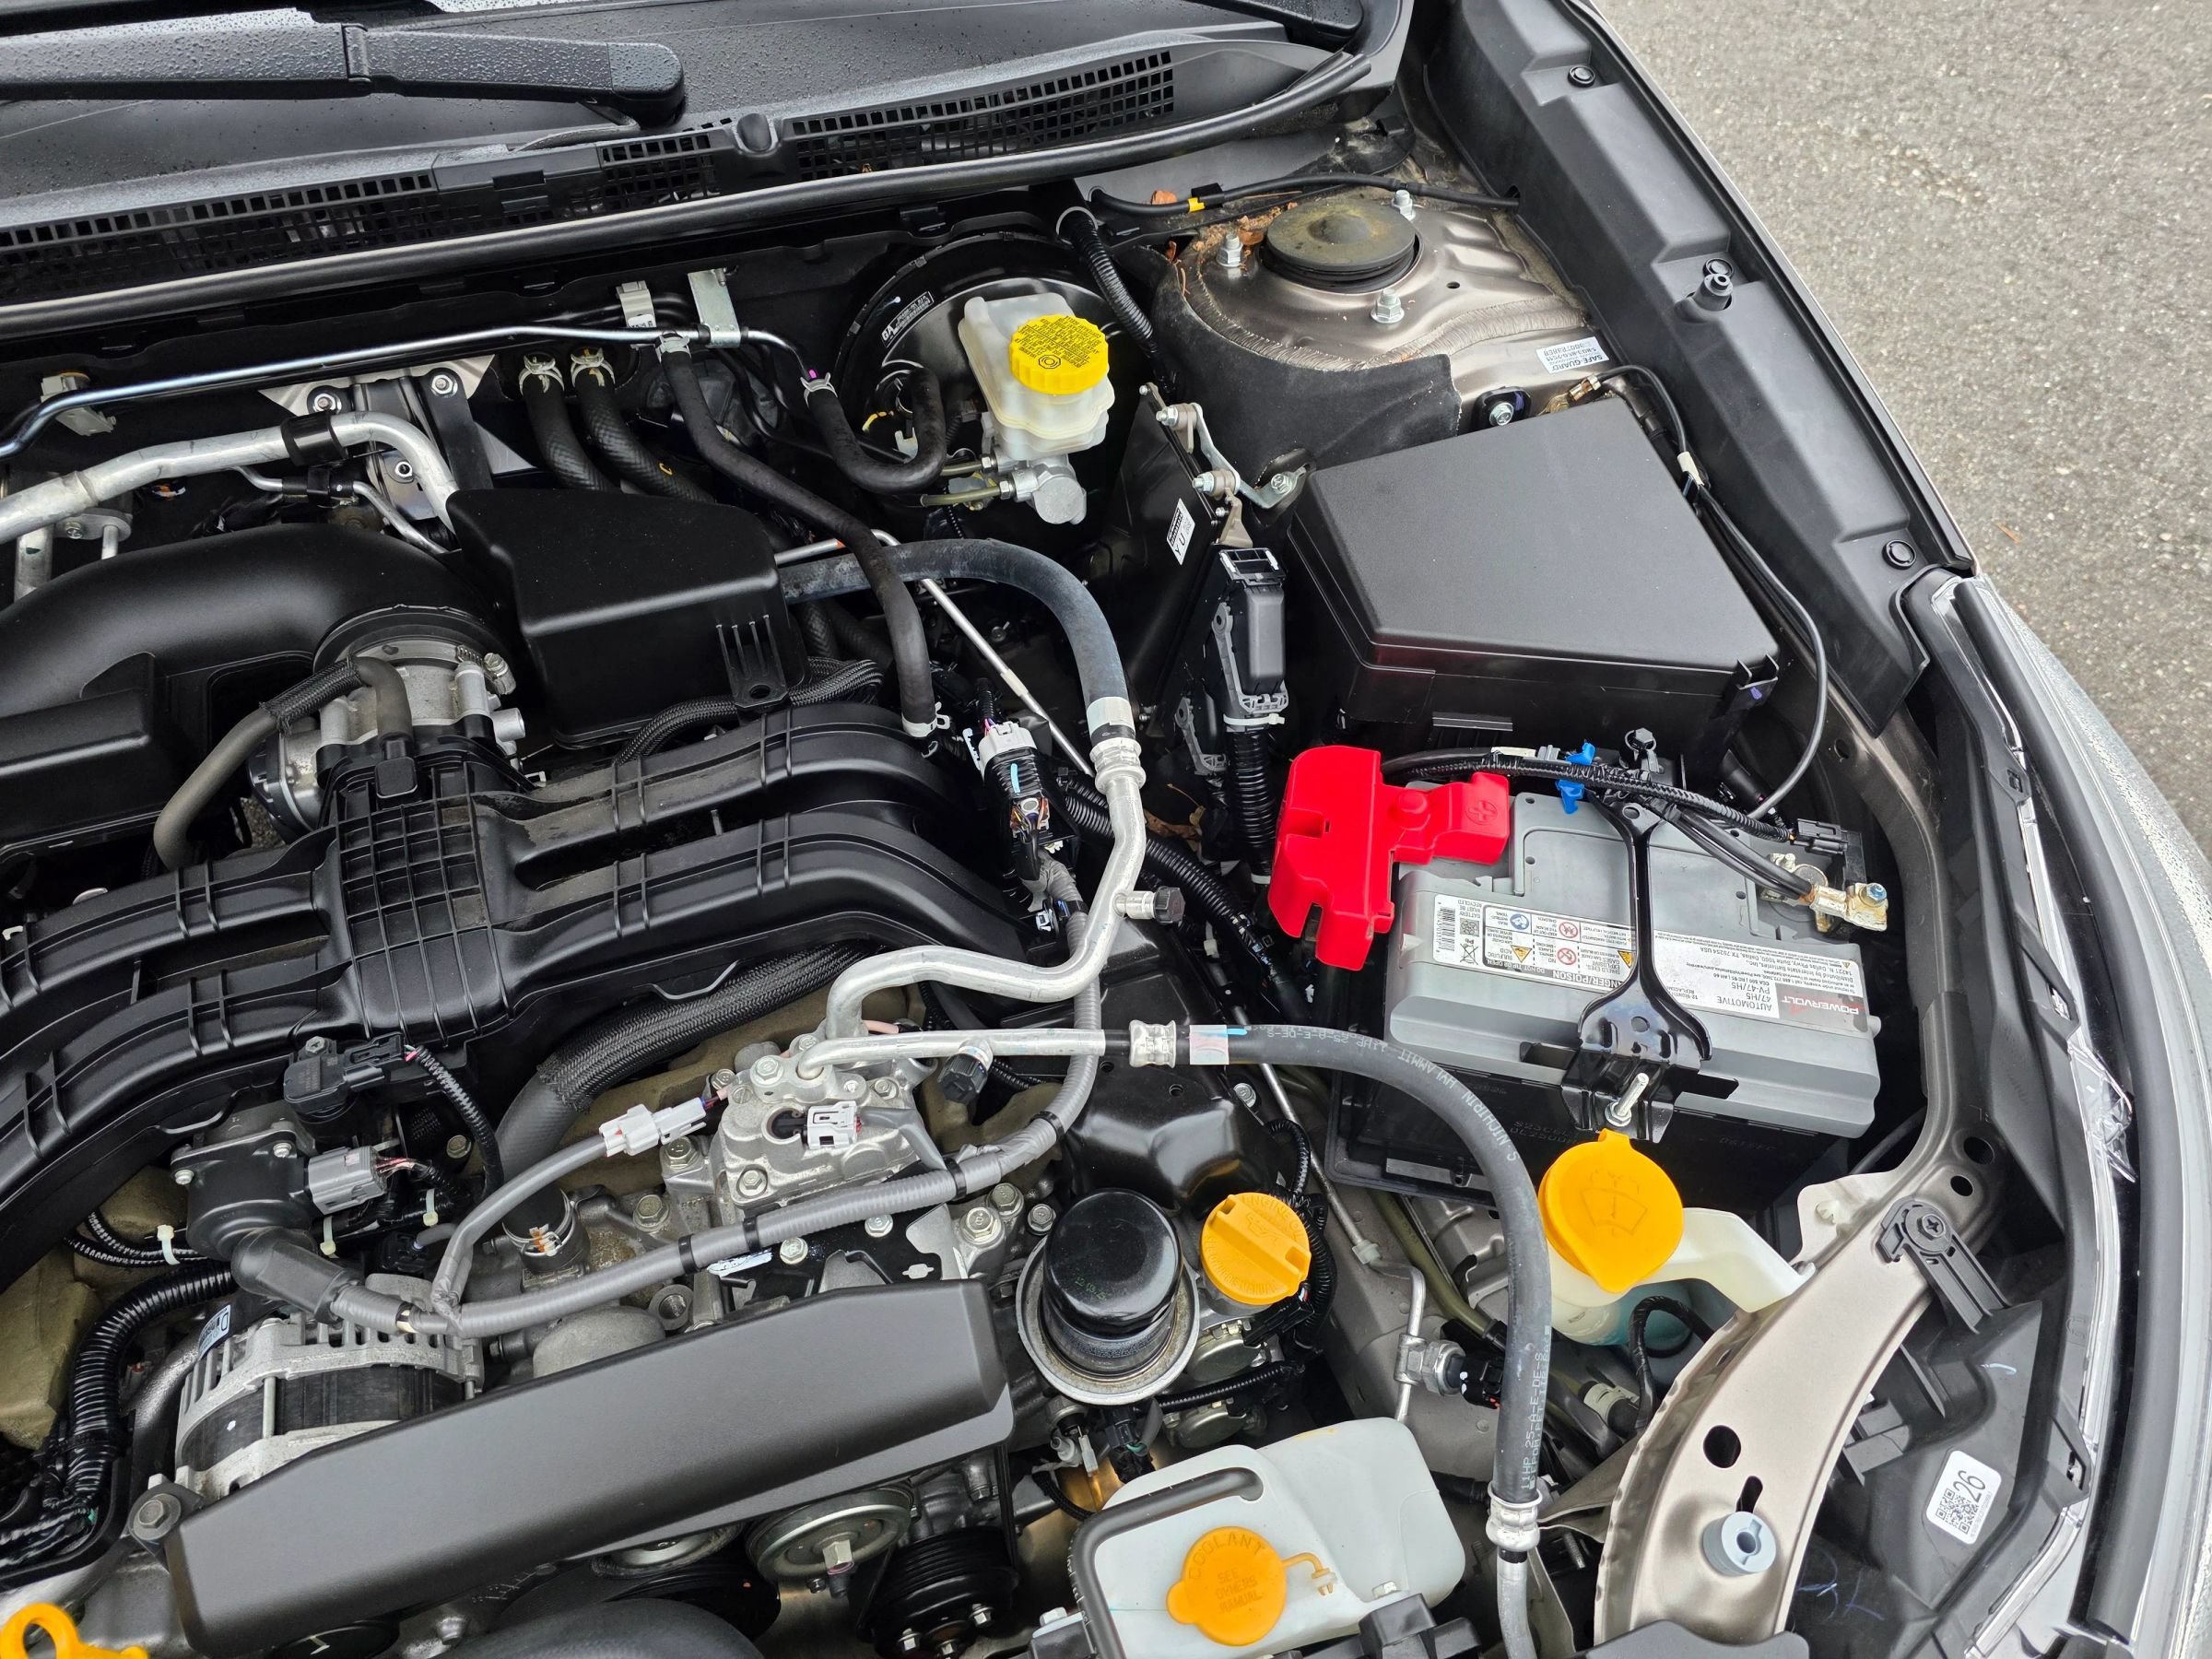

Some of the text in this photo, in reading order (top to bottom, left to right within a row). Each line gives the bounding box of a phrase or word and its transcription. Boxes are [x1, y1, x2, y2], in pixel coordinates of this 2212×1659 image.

[1552, 354, 1602, 371] SAFE-GUARD
[1552, 969, 1621, 989] ANGER/POISON
[1731, 981, 1770, 994] PV-47/H5
[1716, 995, 1772, 1012] AUTOMOTIVE
[1745, 991, 1771, 1003] 47/H5
[1781, 994, 1859, 1015] POWERVOLT
[1460, 1090, 1511, 1146] NICHIRIN
[1524, 1352, 1542, 1448] 25-A-E-DE-S
[1952, 1468, 1984, 1502] 26
[1189, 1532, 1265, 1579] COOLANT
